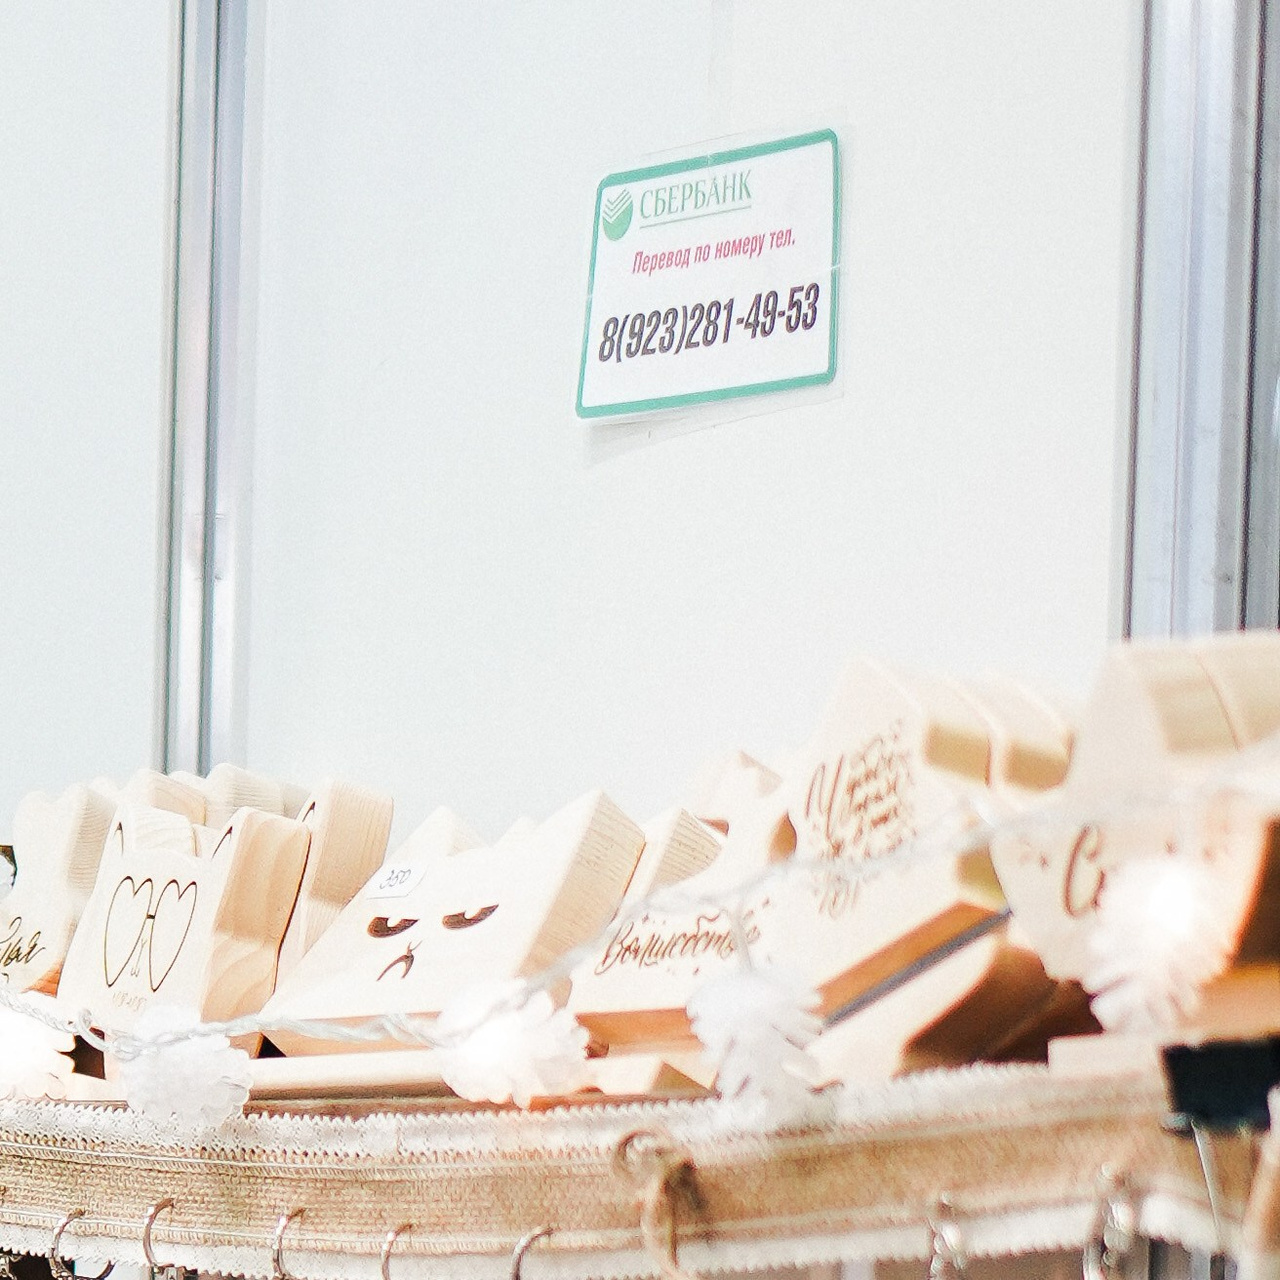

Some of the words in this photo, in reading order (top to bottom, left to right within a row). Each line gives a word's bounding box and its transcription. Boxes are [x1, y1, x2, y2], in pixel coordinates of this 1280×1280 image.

[640, 169, 752, 220] СБЕРБАНК
[632, 246, 690, 277] Перевод
[694, 246, 710, 264] по
[714, 232, 765, 261] номеру
[769, 228, 795, 249] тел.
[598, 282, 821, 363] 8(923)281-49-53
